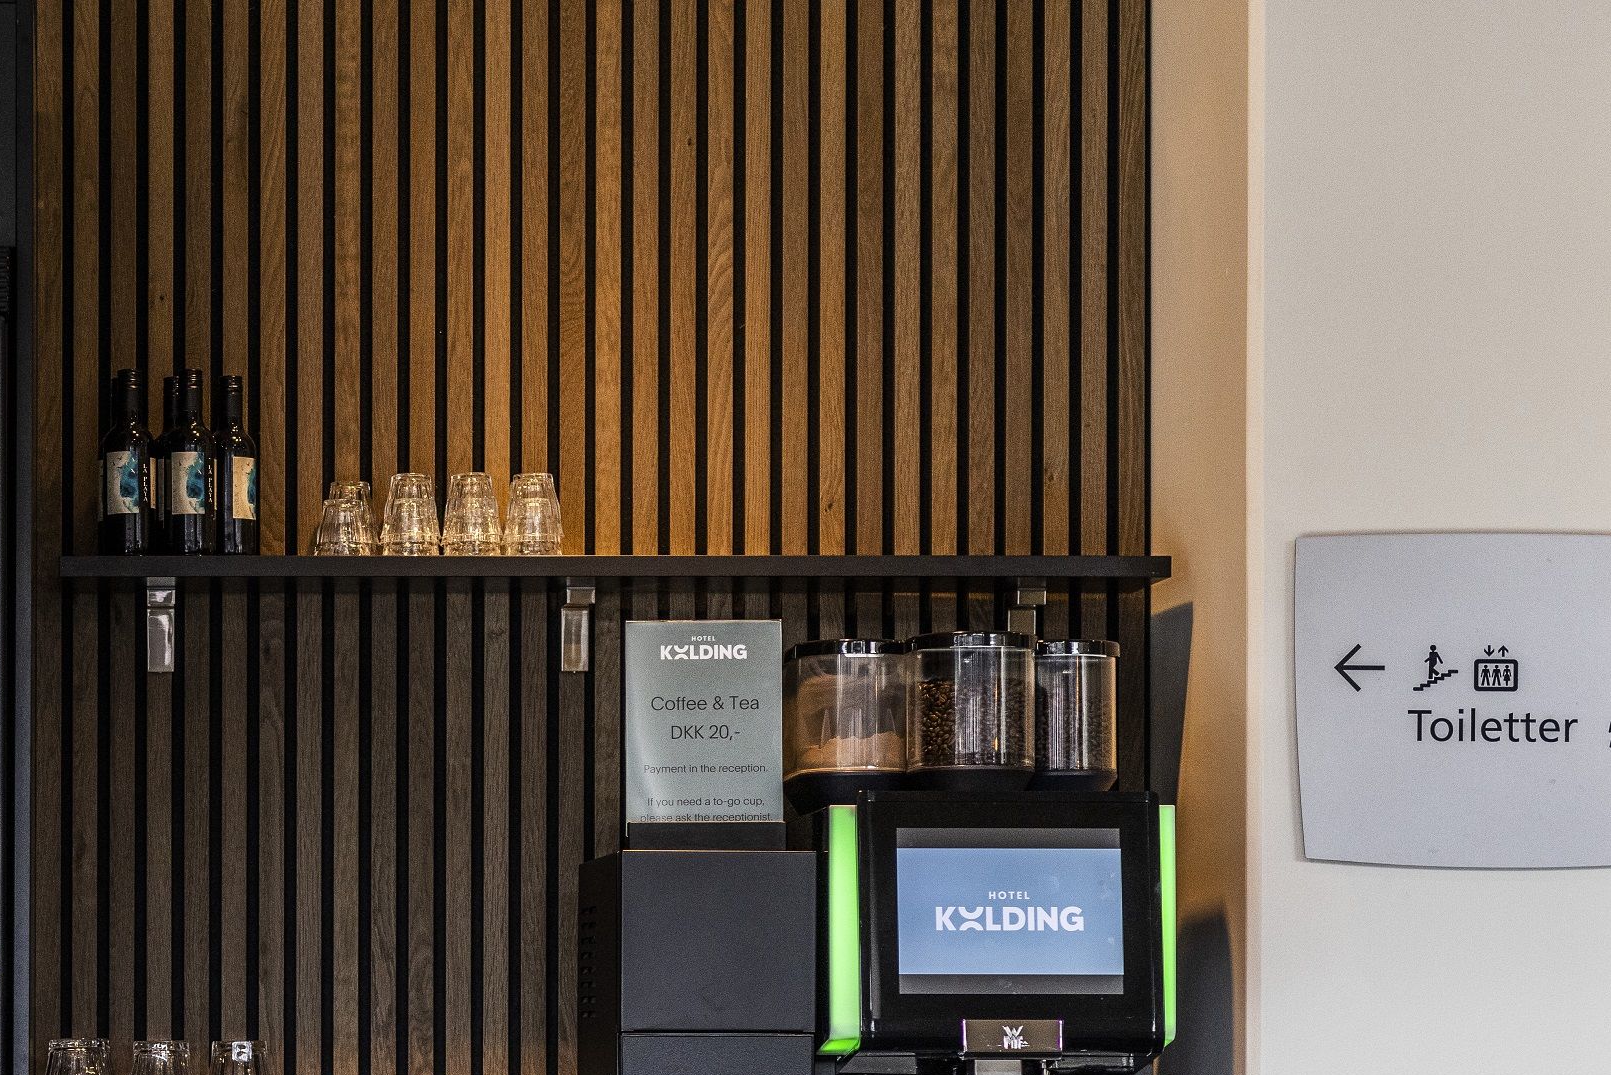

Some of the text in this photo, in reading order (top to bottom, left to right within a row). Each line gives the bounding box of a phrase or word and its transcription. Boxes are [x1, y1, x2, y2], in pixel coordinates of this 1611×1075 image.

[650, 695, 760, 711] Coffee & Tea
[1407, 708, 1578, 743] Toiletter
[671, 724, 741, 741] DKK 20,-
[644, 763, 769, 775] Payment in the reception.
[656, 799, 675, 808] you
[676, 798, 702, 806] need
[713, 798, 741, 808] to-go
[675, 813, 692, 822] ask
[694, 813, 710, 822] the
[988, 891, 1030, 900] HOTEL
